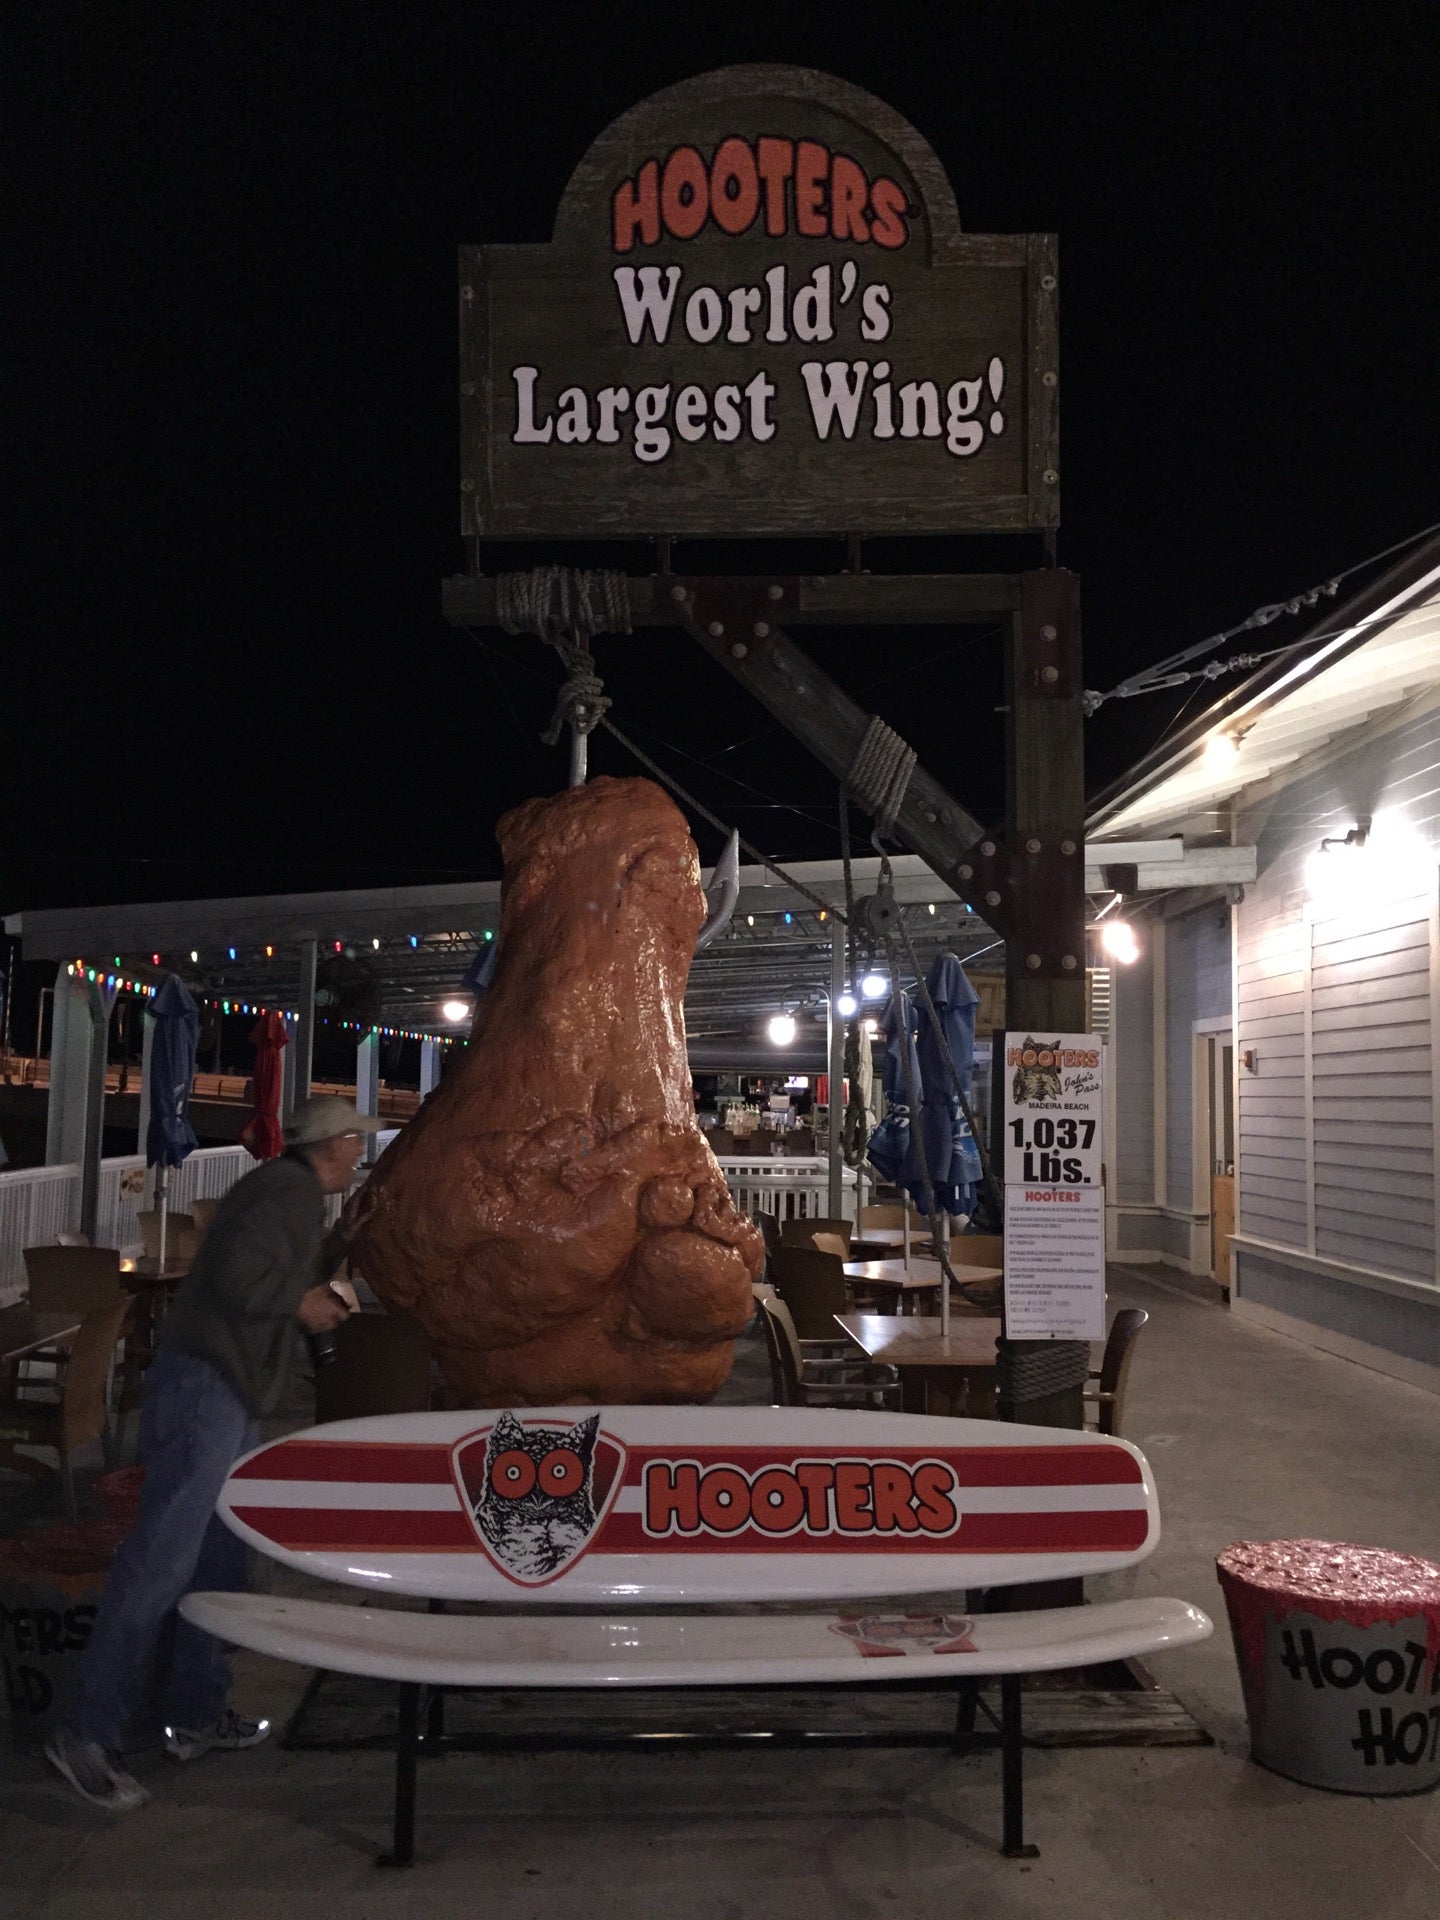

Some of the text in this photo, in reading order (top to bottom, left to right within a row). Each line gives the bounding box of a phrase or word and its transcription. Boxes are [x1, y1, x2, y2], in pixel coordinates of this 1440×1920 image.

[612, 134, 911, 254] HOOTERS
[612, 260, 892, 345] World's
[511, 355, 1005, 463] Largest Wing!
[1007, 1047, 1099, 1068] HOOTERS
[1064, 1072, 1095, 1092] John's
[1074, 1083, 1100, 1096] Pass
[1028, 1102, 1089, 1110] MADEIRA BEACH
[1008, 1118, 1096, 1151] 1,037
[1023, 1152, 1091, 1184] Lbs.
[1024, 1191, 1082, 1203] HOOTERS
[644, 1461, 959, 1536] HOOTERS
